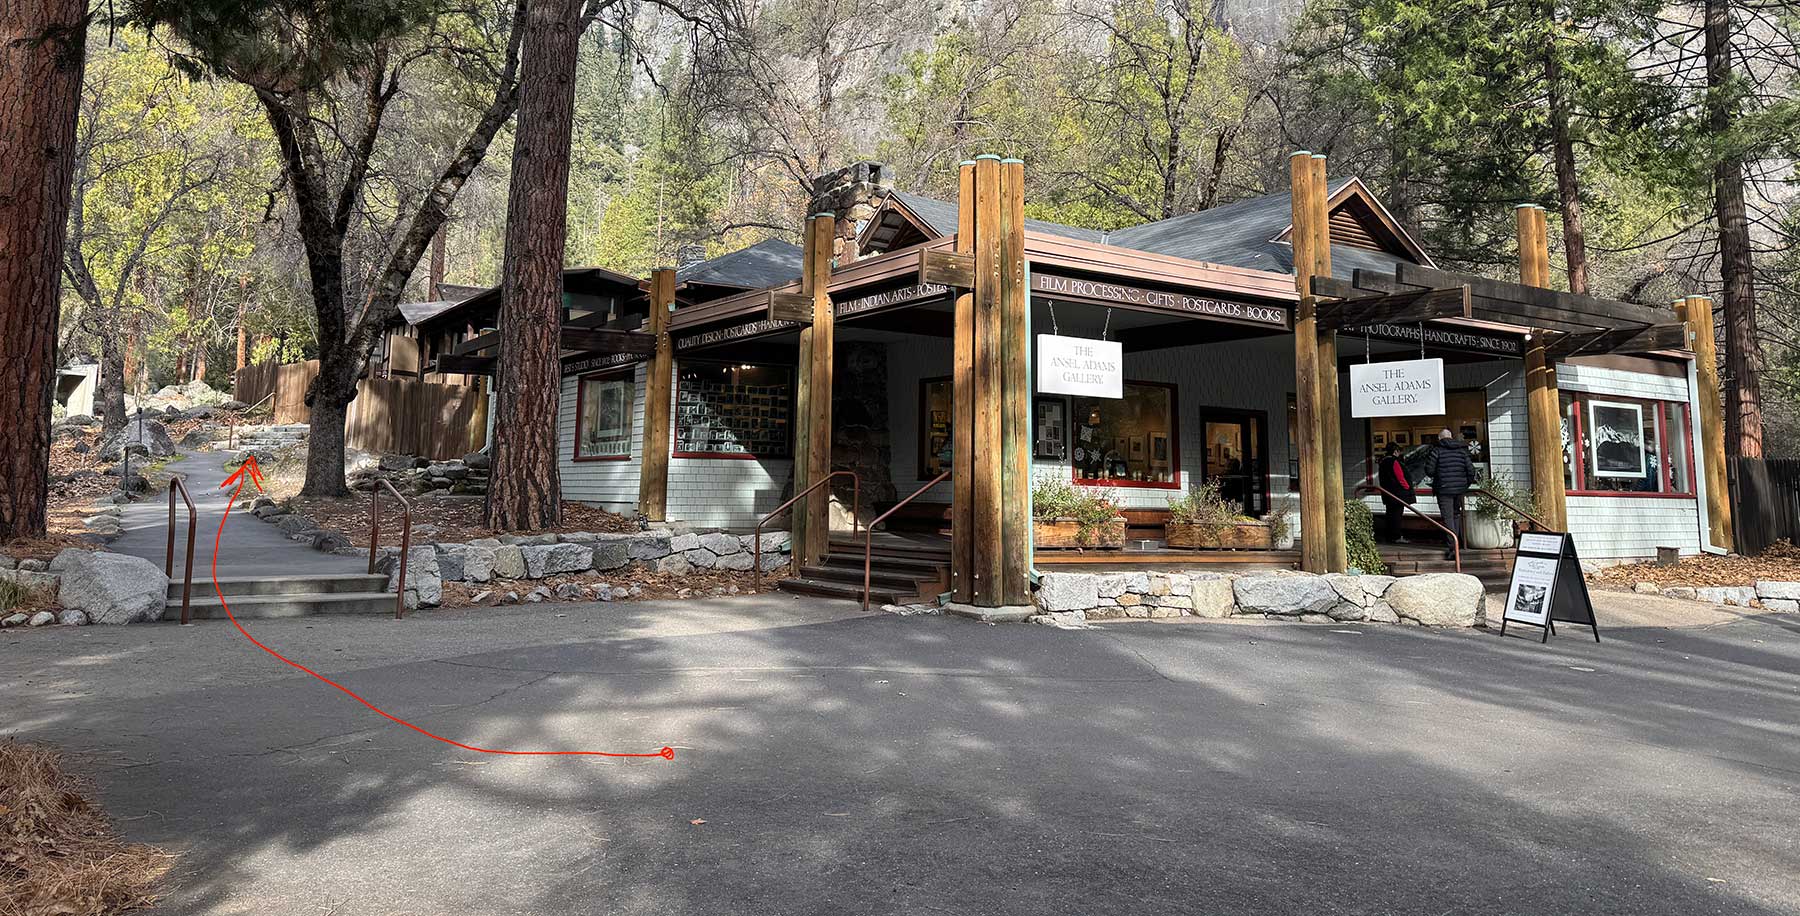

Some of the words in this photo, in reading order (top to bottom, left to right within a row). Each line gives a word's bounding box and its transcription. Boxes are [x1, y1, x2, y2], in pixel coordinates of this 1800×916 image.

[839, 300, 858, 314] FILM
[860, 292, 893, 310] INDIAN
[892, 286, 912, 303] ARTS
[1040, 276, 1067, 292] FILM
[1071, 280, 1139, 302] PROCESSING
[1146, 291, 1175, 307] GIFTS
[1182, 297, 1240, 316] POSTCARDS
[1247, 306, 1281, 322] BOOKS
[1424, 330, 1476, 346] HANDCRAFTS
[1480, 336, 1500, 350] SINCE
[1074, 346, 1093, 357] THE
[1051, 357, 1080, 369] ANSEL
[1083, 360, 1116, 372] ADAMS
[1382, 368, 1405, 379] THE
[1360, 382, 1391, 393] ANSEL
[1394, 379, 1432, 392] ADAMS
